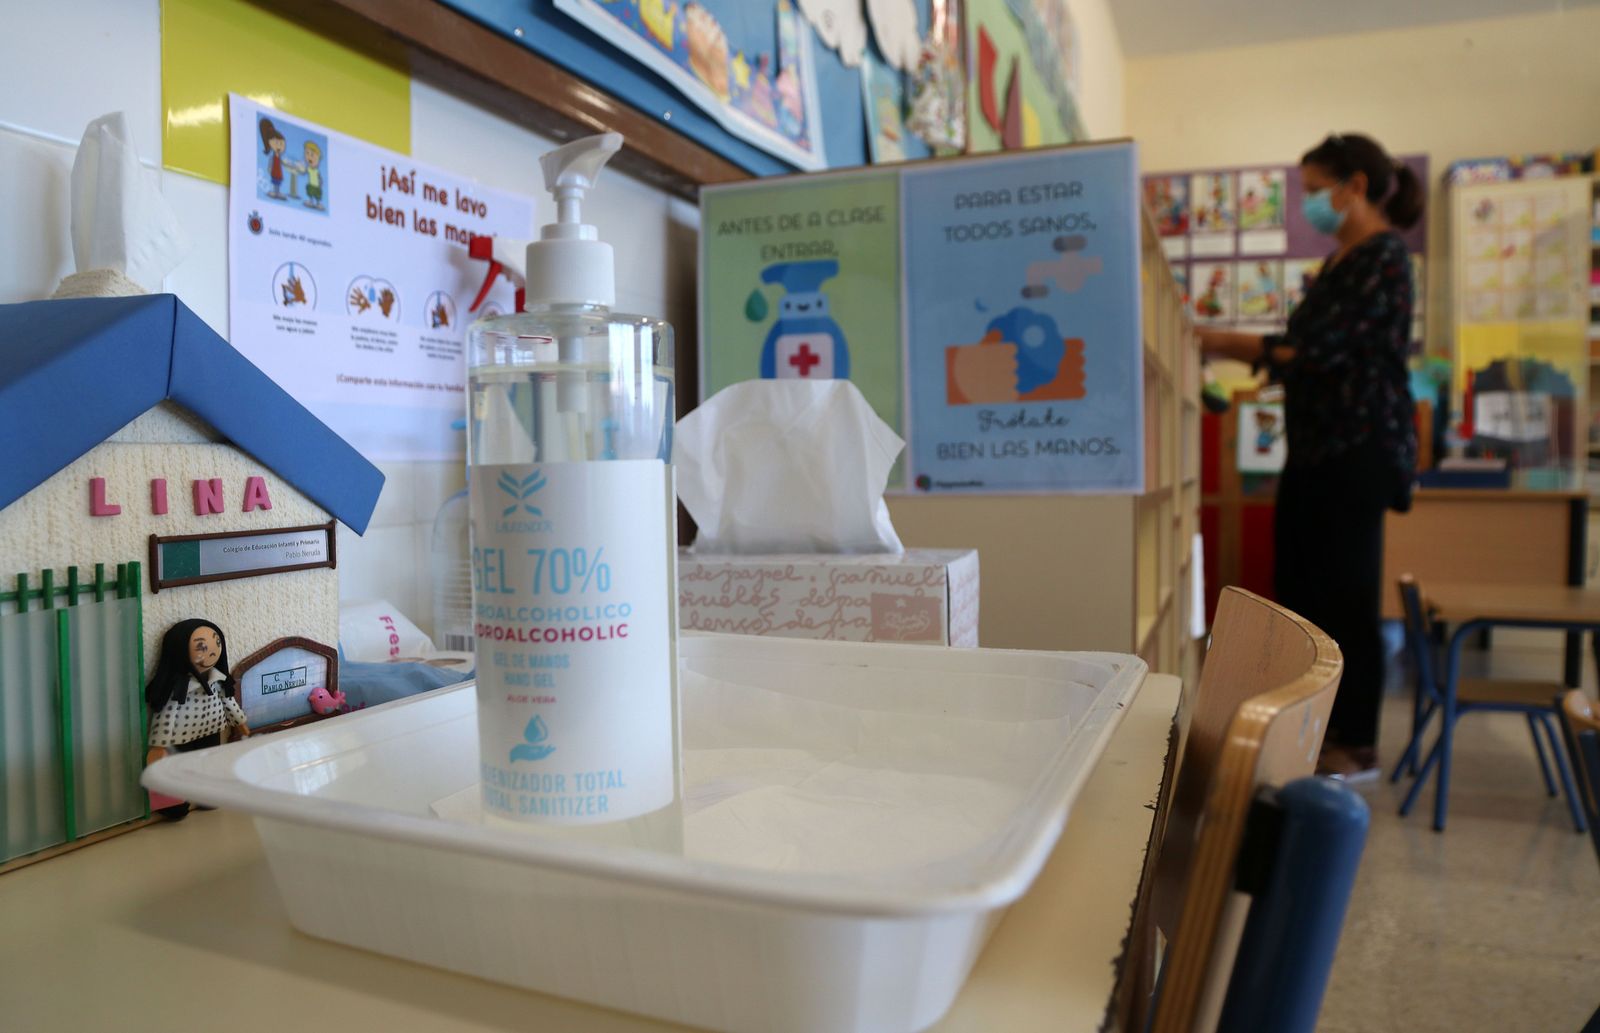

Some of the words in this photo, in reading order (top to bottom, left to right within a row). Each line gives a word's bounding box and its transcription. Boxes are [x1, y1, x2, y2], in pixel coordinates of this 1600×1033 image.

[381, 165, 416, 195] ¡Así
[423, 182, 448, 206] me
[456, 187, 487, 219] lavo
[953, 187, 1012, 210] PARA
[1017, 180, 1083, 205] ESTAR
[366, 193, 405, 229] bien
[413, 208, 438, 237] las
[717, 213, 774, 237] ANTES
[777, 212, 802, 233] DE
[807, 210, 821, 228] A
[827, 204, 885, 228] CLASE
[943, 219, 1014, 243] TODOS
[937, 440, 985, 462] BIEN
[990, 439, 1030, 460] LAS
[90, 476, 272, 517] LINA
[223, 544, 244, 554] Colegio
[251, 542, 278, 552] Educación
[300, 538, 320, 546] Primaria
[285, 549, 301, 560] Pablo
[301, 547, 321, 558] Neruda
[527, 546, 612, 595] 70%
[528, 653, 571, 669] MANOS
[274, 673, 280, 682] C
[289, 669, 295, 679] P
[533, 672, 557, 688] GEL
[574, 768, 626, 793] TOTAL
[517, 794, 609, 818] SANITIZER
